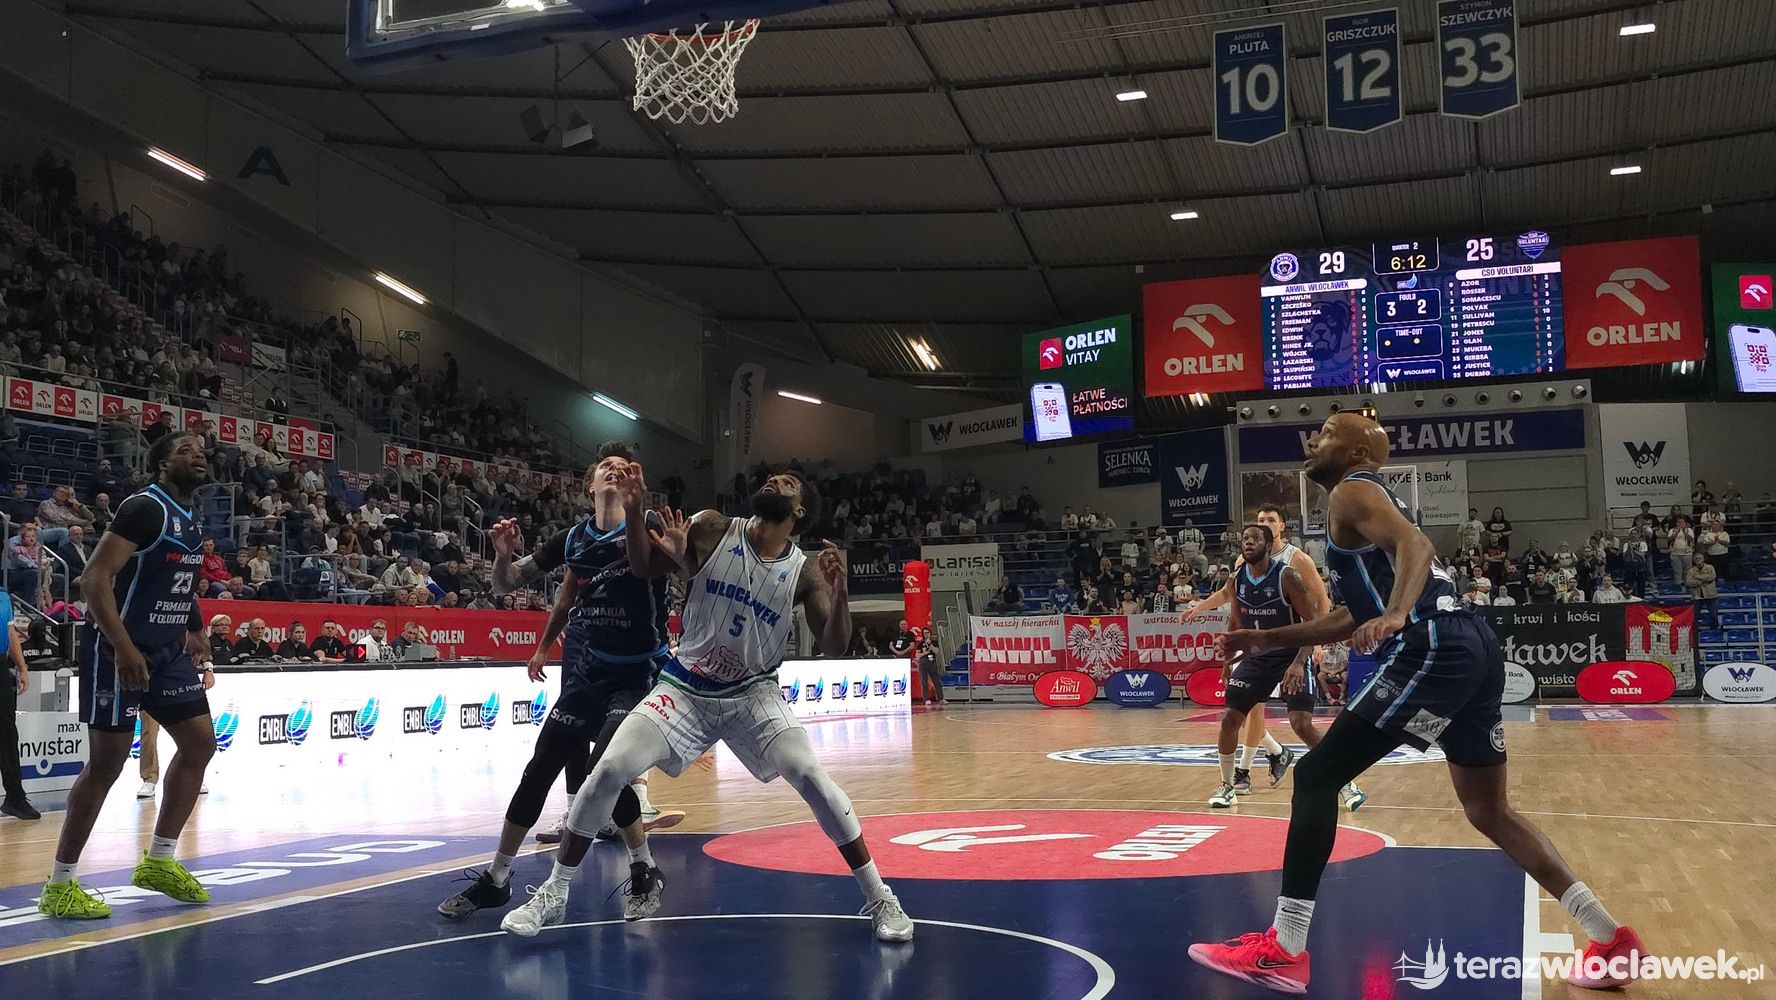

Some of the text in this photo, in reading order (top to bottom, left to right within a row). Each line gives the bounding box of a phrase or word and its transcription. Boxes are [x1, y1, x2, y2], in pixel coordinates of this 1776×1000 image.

[1440, 7, 1513, 27] SZEWCZYK
[1327, 24, 1396, 43] GRISZCZUK
[1229, 41, 1269, 54] PLUTA
[1444, 33, 1514, 88] 33
[1334, 49, 1391, 101] 12
[1221, 64, 1279, 114] 10
[238, 146, 290, 186] A
[1466, 238, 1494, 261] 25
[1320, 252, 1345, 274] 29
[1391, 255, 1426, 270] 6:12
[1496, 266, 1534, 275] VOLUNTARI
[1286, 285, 1306, 293] ANWIL
[1387, 302, 1396, 316] 3
[1418, 299, 1426, 314] 2
[1065, 328, 1116, 350] ORLEN
[1587, 321, 1680, 346] ORLEN
[1066, 350, 1100, 366] VITAY
[1164, 353, 1244, 376] ORLEN
[1072, 388, 1106, 403] ŁATWE
[1074, 397, 1128, 416] PŁATNOŚCI
[959, 416, 1018, 434] WŁOCŁAWEK
[1105, 450, 1152, 472] SELENKA
[1425, 472, 1452, 482] Bank
[1616, 476, 1679, 486] WŁOCŁAWEK
[1168, 494, 1219, 508] WŁOCŁAWEK
[888, 563, 906, 574] BU
[171, 571, 194, 594] 23
[155, 601, 191, 612] PRMARIA
[706, 578, 782, 628] WŁOCŁAWEK
[729, 614, 746, 638] 5
[994, 618, 1019, 629] naszej
[1022, 617, 1060, 628] hierarchii
[1144, 616, 1180, 624] wartośc
[1496, 616, 1504, 624] z
[1514, 613, 1542, 624] krwi
[1554, 612, 1557, 623] i
[1568, 611, 1600, 622] kości
[430, 630, 464, 644] ORLEN
[506, 631, 536, 644] ORLEN
[974, 636, 1056, 664] ANWIL
[1500, 633, 1608, 666] ławek
[697, 647, 749, 679] Anwil
[996, 672, 1026, 683] Białym
[1050, 678, 1080, 694] Anwil
[462, 706, 480, 726] ENBL
[514, 704, 530, 722] ENBL
[644, 701, 670, 720] ORLEN
[58, 723, 80, 733] max
[261, 718, 286, 742] ENBL
[332, 714, 354, 736] ENBL
[404, 710, 424, 731] ENBL
[20, 737, 82, 758] nvistar
[1092, 825, 1228, 860] ORLEN
